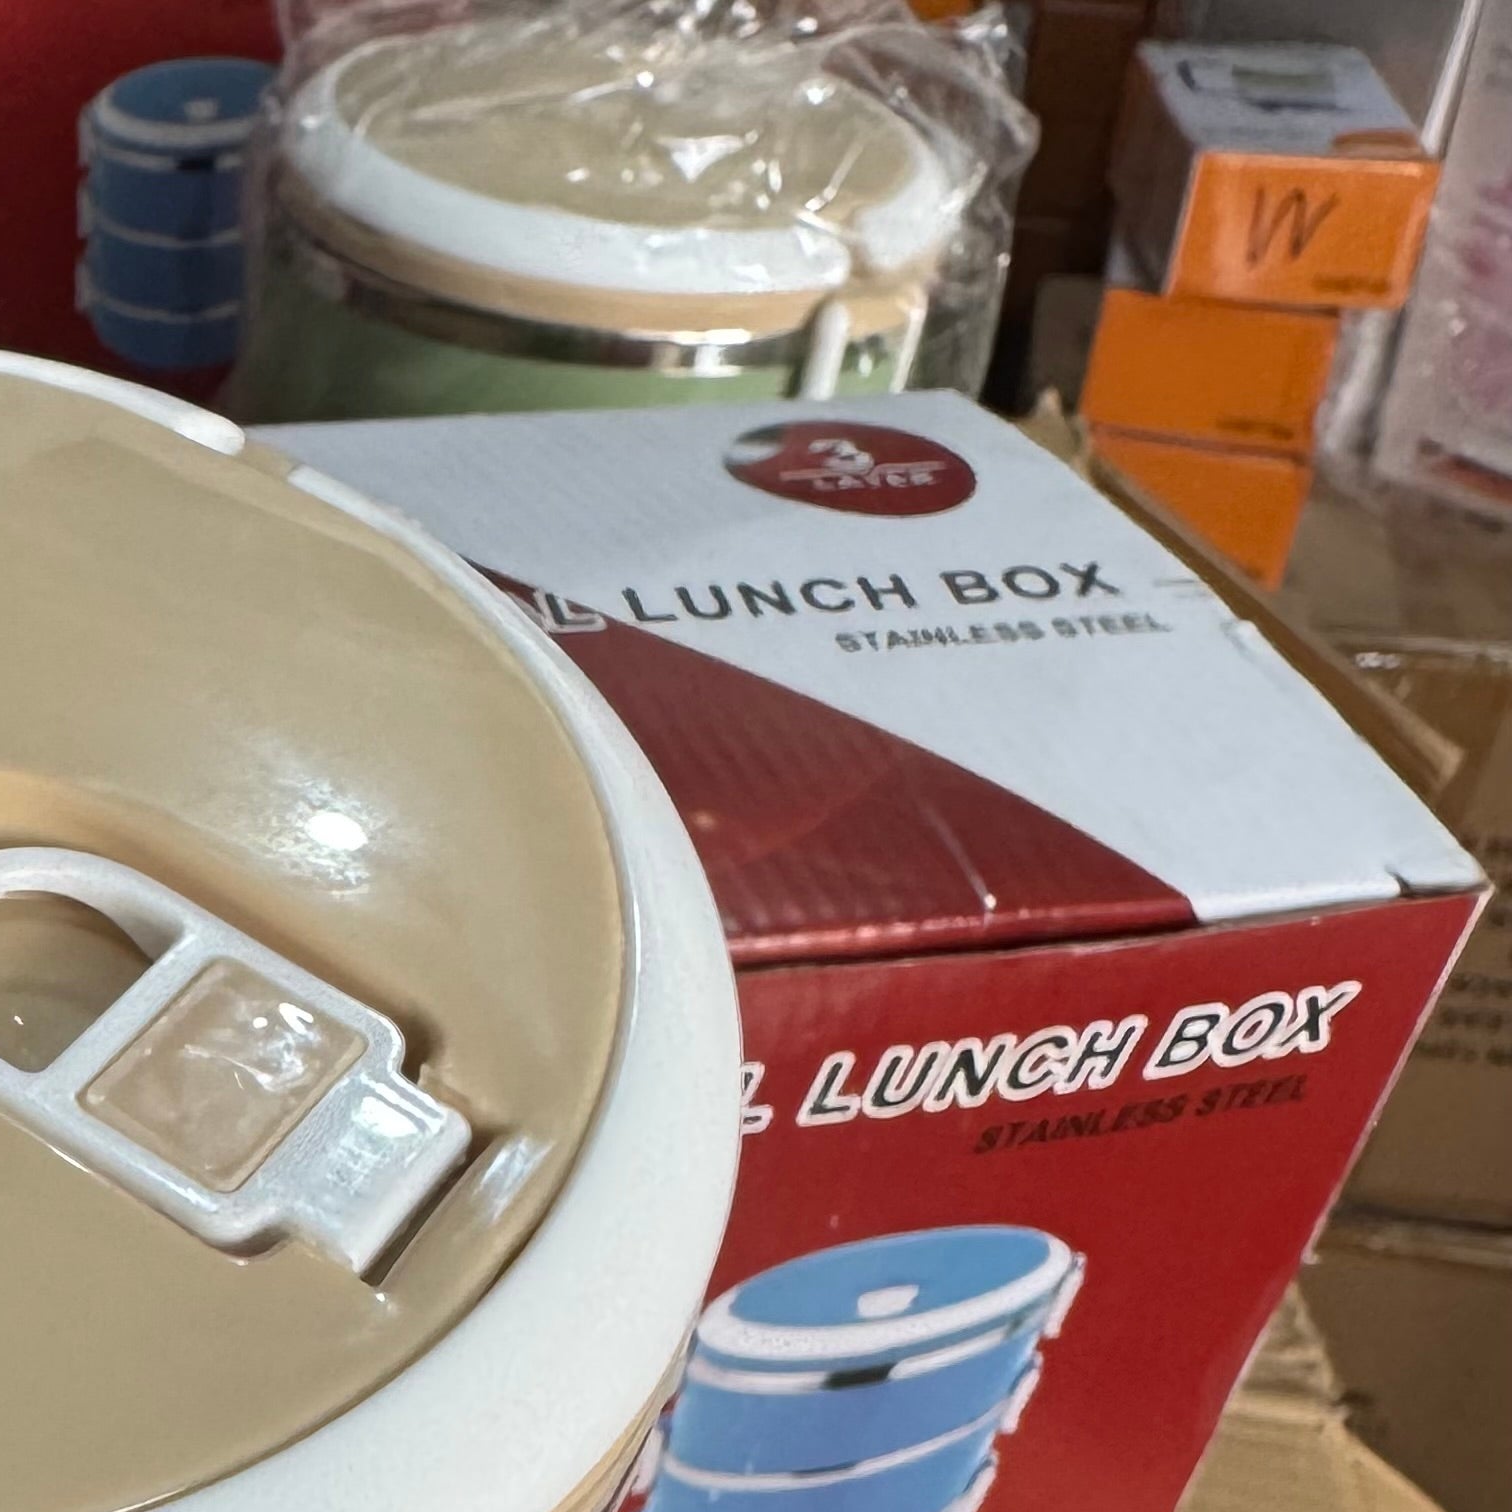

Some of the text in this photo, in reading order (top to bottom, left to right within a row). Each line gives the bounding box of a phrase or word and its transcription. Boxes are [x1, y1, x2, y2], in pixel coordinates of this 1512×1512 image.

[620, 572, 919, 624] LUNCH
[940, 561, 1121, 606] BOX
[834, 601, 1174, 653] STAINLESS STEEL
[795, 1013, 1150, 1128] LUNCH
[1143, 980, 1363, 1081] BOX
[973, 1074, 1308, 1154] STAINLESS STEEL
